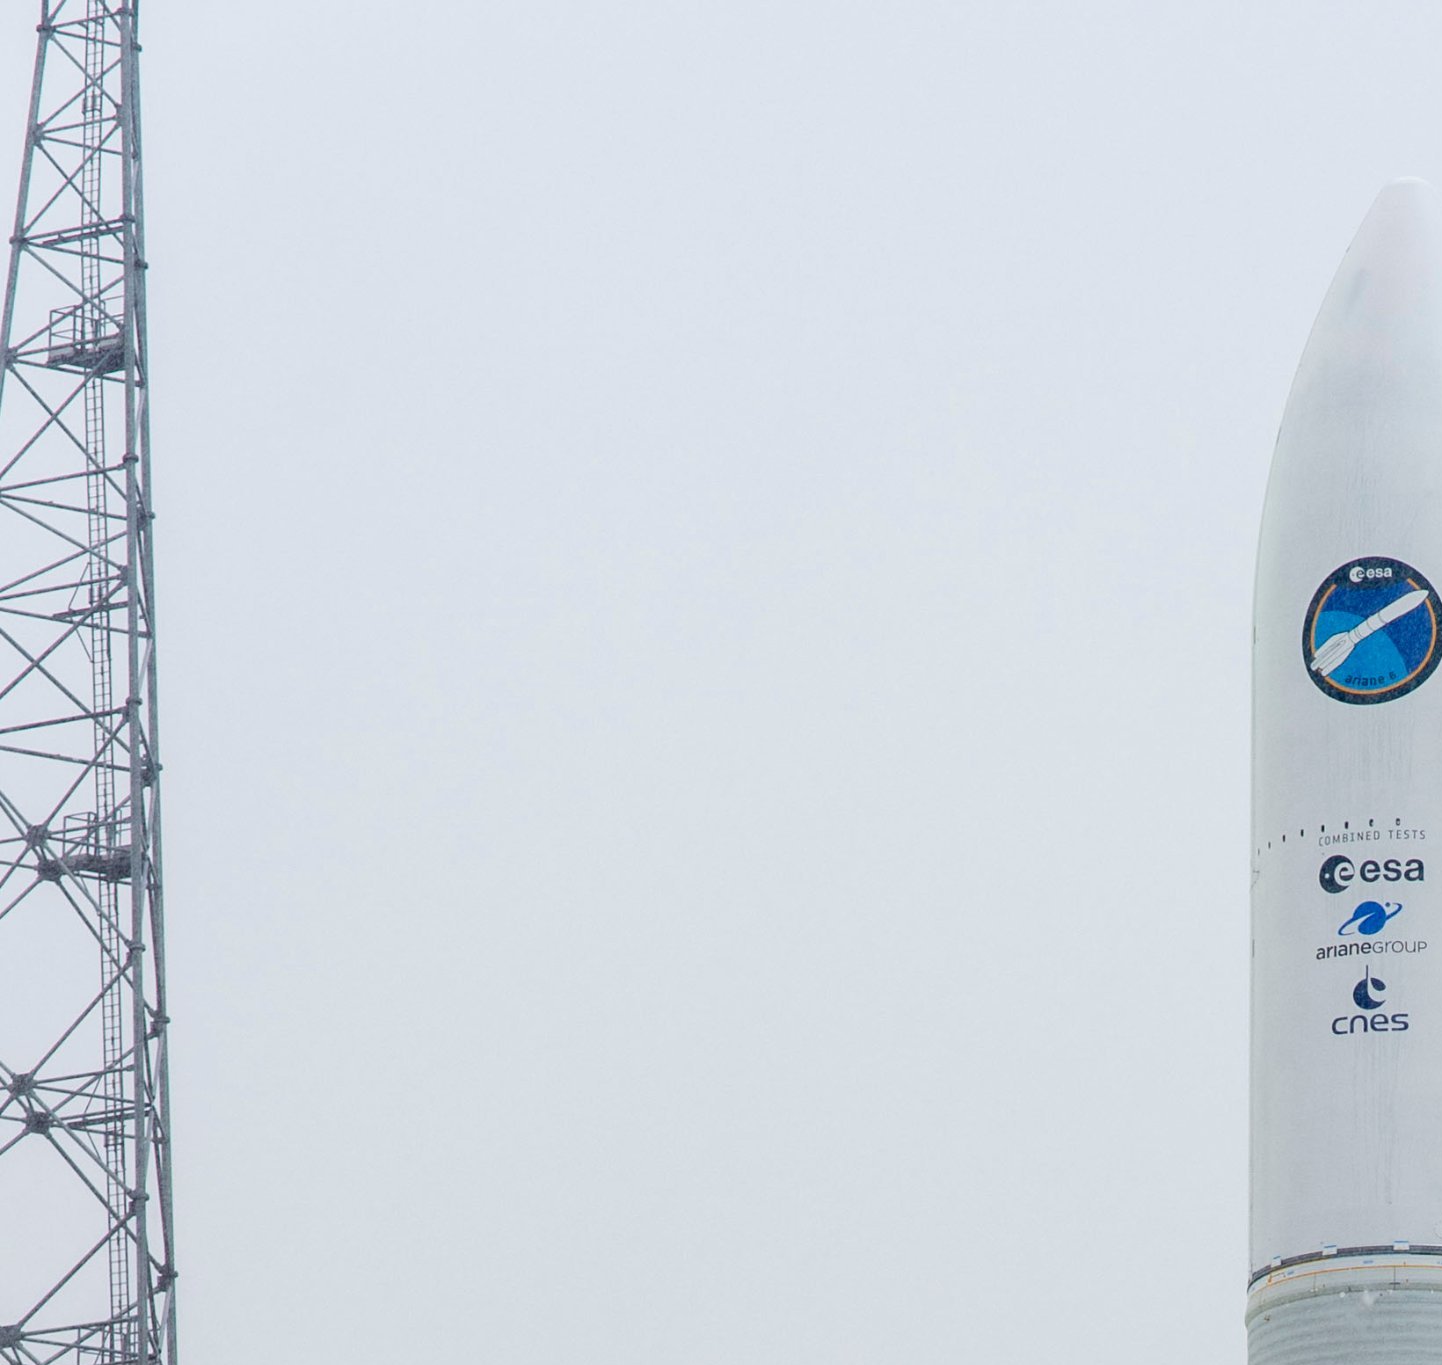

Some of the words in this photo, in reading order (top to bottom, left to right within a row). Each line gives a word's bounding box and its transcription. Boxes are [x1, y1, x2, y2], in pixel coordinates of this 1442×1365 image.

[1366, 566, 1393, 579] esa
[1344, 673, 1385, 687] ariane
[1388, 671, 1397, 680] 6
[1318, 830, 1381, 847] COMBINED
[1387, 829, 1427, 841] TESTS
[1359, 858, 1425, 883] esa
[1331, 1013, 1410, 1035] cnes
